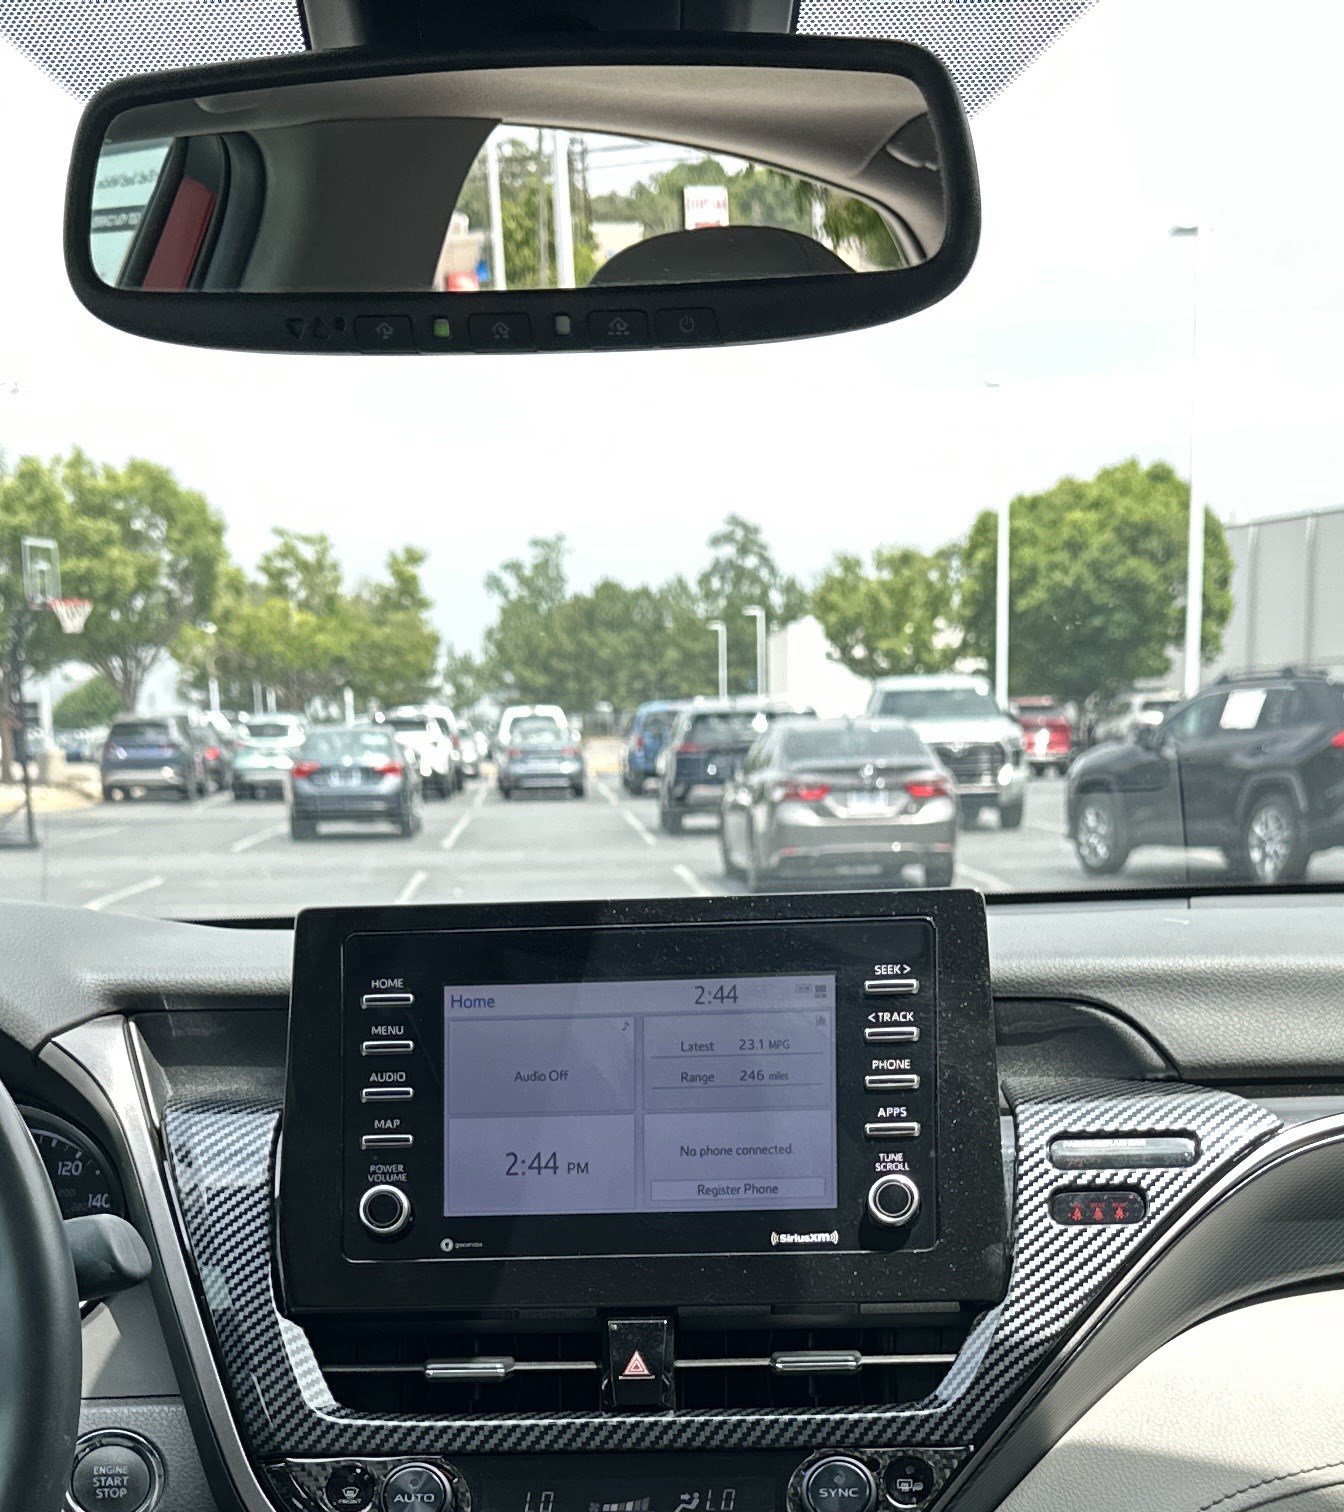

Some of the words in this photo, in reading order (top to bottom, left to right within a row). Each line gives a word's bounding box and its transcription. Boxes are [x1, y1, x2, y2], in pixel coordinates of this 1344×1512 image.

[874, 964, 901, 975] SEEK
[371, 978, 404, 989] HOME
[694, 984, 739, 1006] 2:44
[450, 993, 496, 1009] Home
[877, 1011, 915, 1022] TRACK
[371, 1025, 404, 1035] MENU
[680, 1040, 716, 1053] Latest
[738, 1038, 765, 1051] 23.1
[768, 1038, 791, 1050] MPG
[872, 1059, 911, 1070] PHONE
[369, 1071, 406, 1082] AUDIO
[513, 1070, 547, 1082] Audio
[548, 1069, 569, 1081] Off
[680, 1071, 716, 1085] Range
[739, 1069, 765, 1081] 246
[768, 1071, 789, 1080] miles
[877, 1107, 908, 1118] APPS
[373, 1119, 401, 1129] MAP
[679, 1145, 697, 1157] No
[699, 1144, 734, 1159] phone
[878, 1153, 904, 1162] TUNE
[57, 1160, 83, 1176] 120
[369, 1164, 404, 1173] POWER
[505, 1151, 560, 1177] 2:44
[567, 1161, 590, 1175] PM
[875, 1163, 910, 1172] SCROLL
[367, 1173, 407, 1182] VOLUME
[697, 1184, 741, 1198] Register
[743, 1183, 779, 1195] Phone
[93, 1465, 129, 1475] ENGINE
[92, 1476, 129, 1487] START
[96, 1488, 127, 1499] STOP
[393, 1493, 435, 1503] AUTO
[818, 1487, 859, 1498] SYNC
